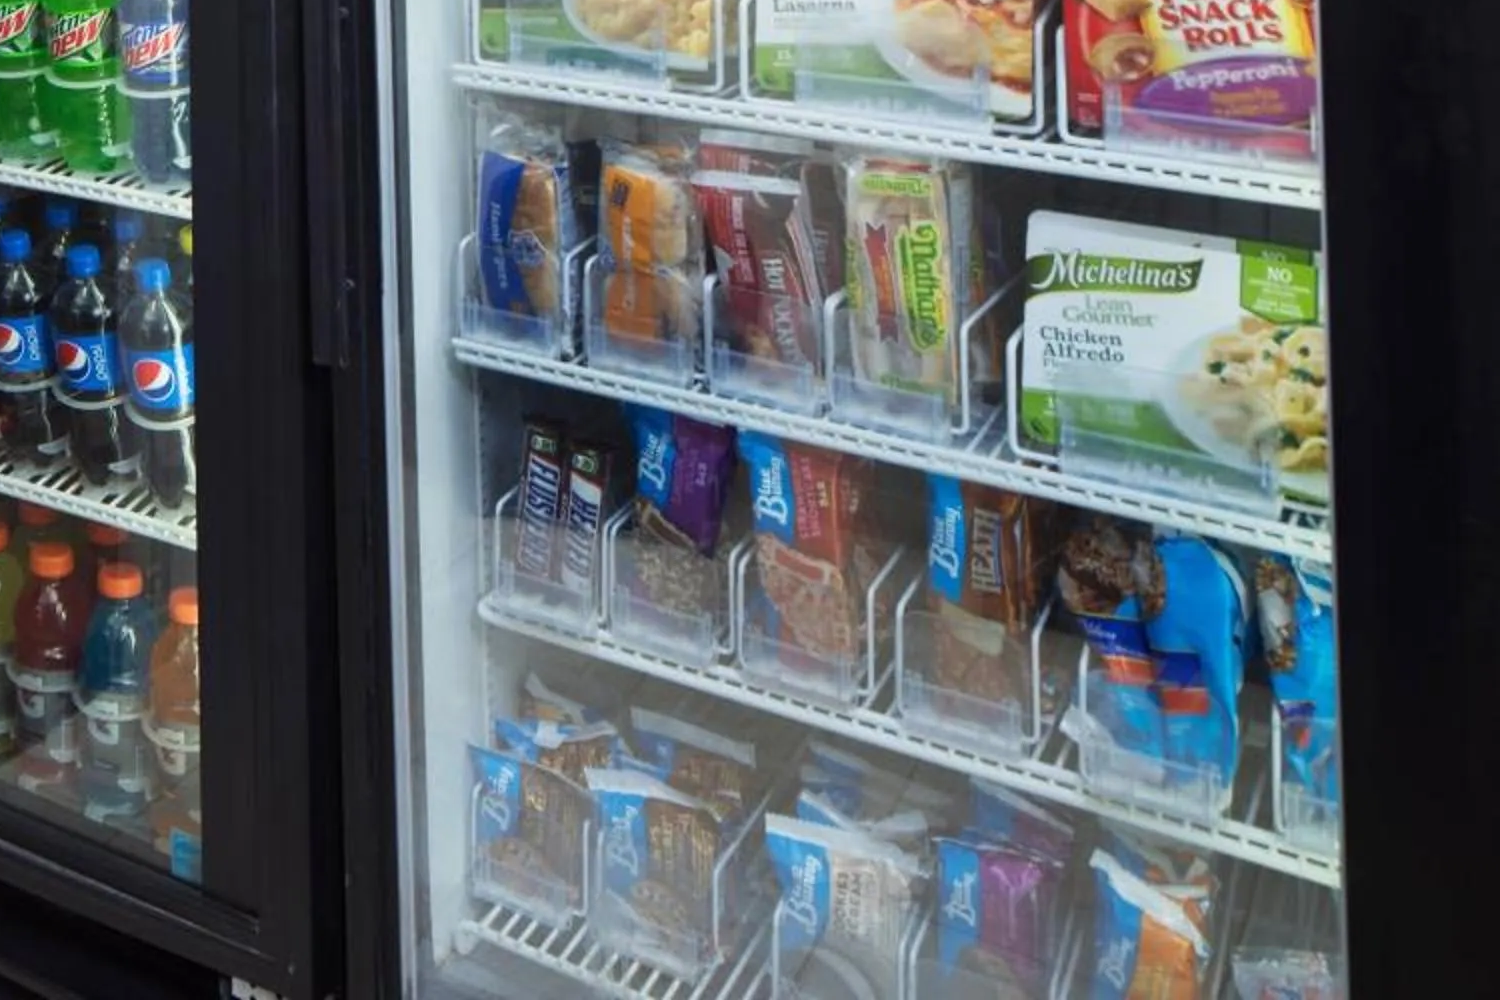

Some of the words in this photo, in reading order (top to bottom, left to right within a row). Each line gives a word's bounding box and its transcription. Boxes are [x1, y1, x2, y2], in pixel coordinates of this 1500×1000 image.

[1182, 23, 1284, 52] ROLLS
[1170, 59, 1299, 91] Pepperoni
[1030, 249, 1194, 290] Michelina's
[1266, 267, 1293, 282] NO
[1085, 295, 1134, 313] Lean
[1062, 306, 1155, 328] Gourmet
[1039, 325, 1123, 347] Chicken
[1043, 342, 1125, 364] Alfredo
[970, 507, 1001, 593] HEATH
